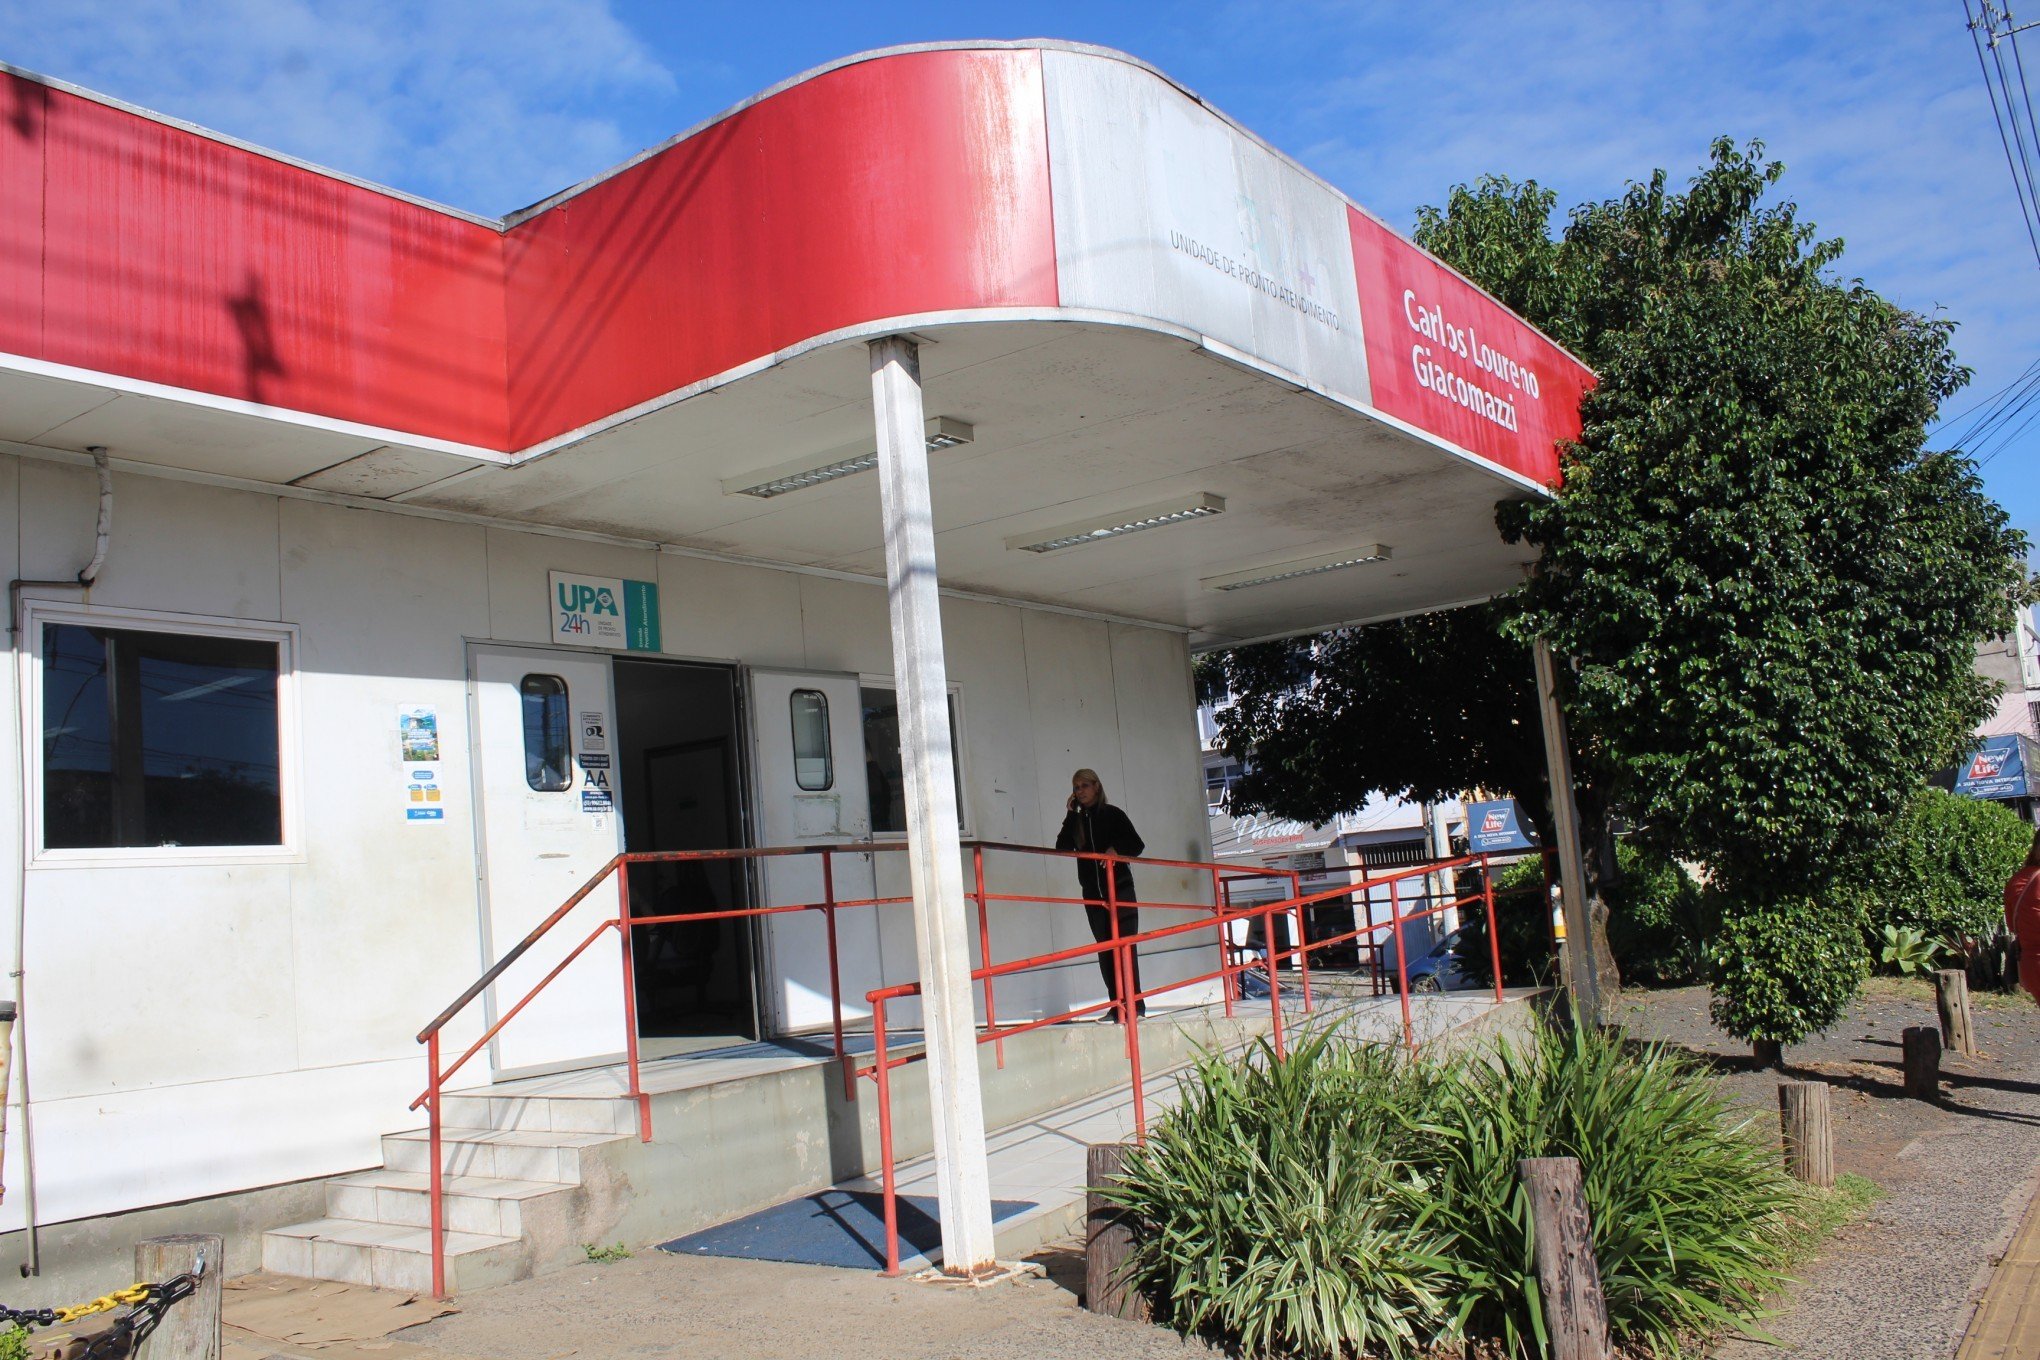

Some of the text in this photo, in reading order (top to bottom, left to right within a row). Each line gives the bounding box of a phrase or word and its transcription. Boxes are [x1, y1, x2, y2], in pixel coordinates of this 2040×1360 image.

[1170, 230, 1340, 331] UNIDADE DE PRONTO ATENDIMENTO
[1403, 289, 1468, 359] Carlos
[1412, 344, 1519, 433] Giacomazzi
[558, 582, 619, 617] UPA
[641, 584, 649, 626] Atendimento
[560, 612, 591, 635] 24h
[1974, 764, 1999, 775] Life
[1978, 754, 2005, 764] New
[584, 769, 609, 787] AA
[1485, 820, 1502, 828] Life
